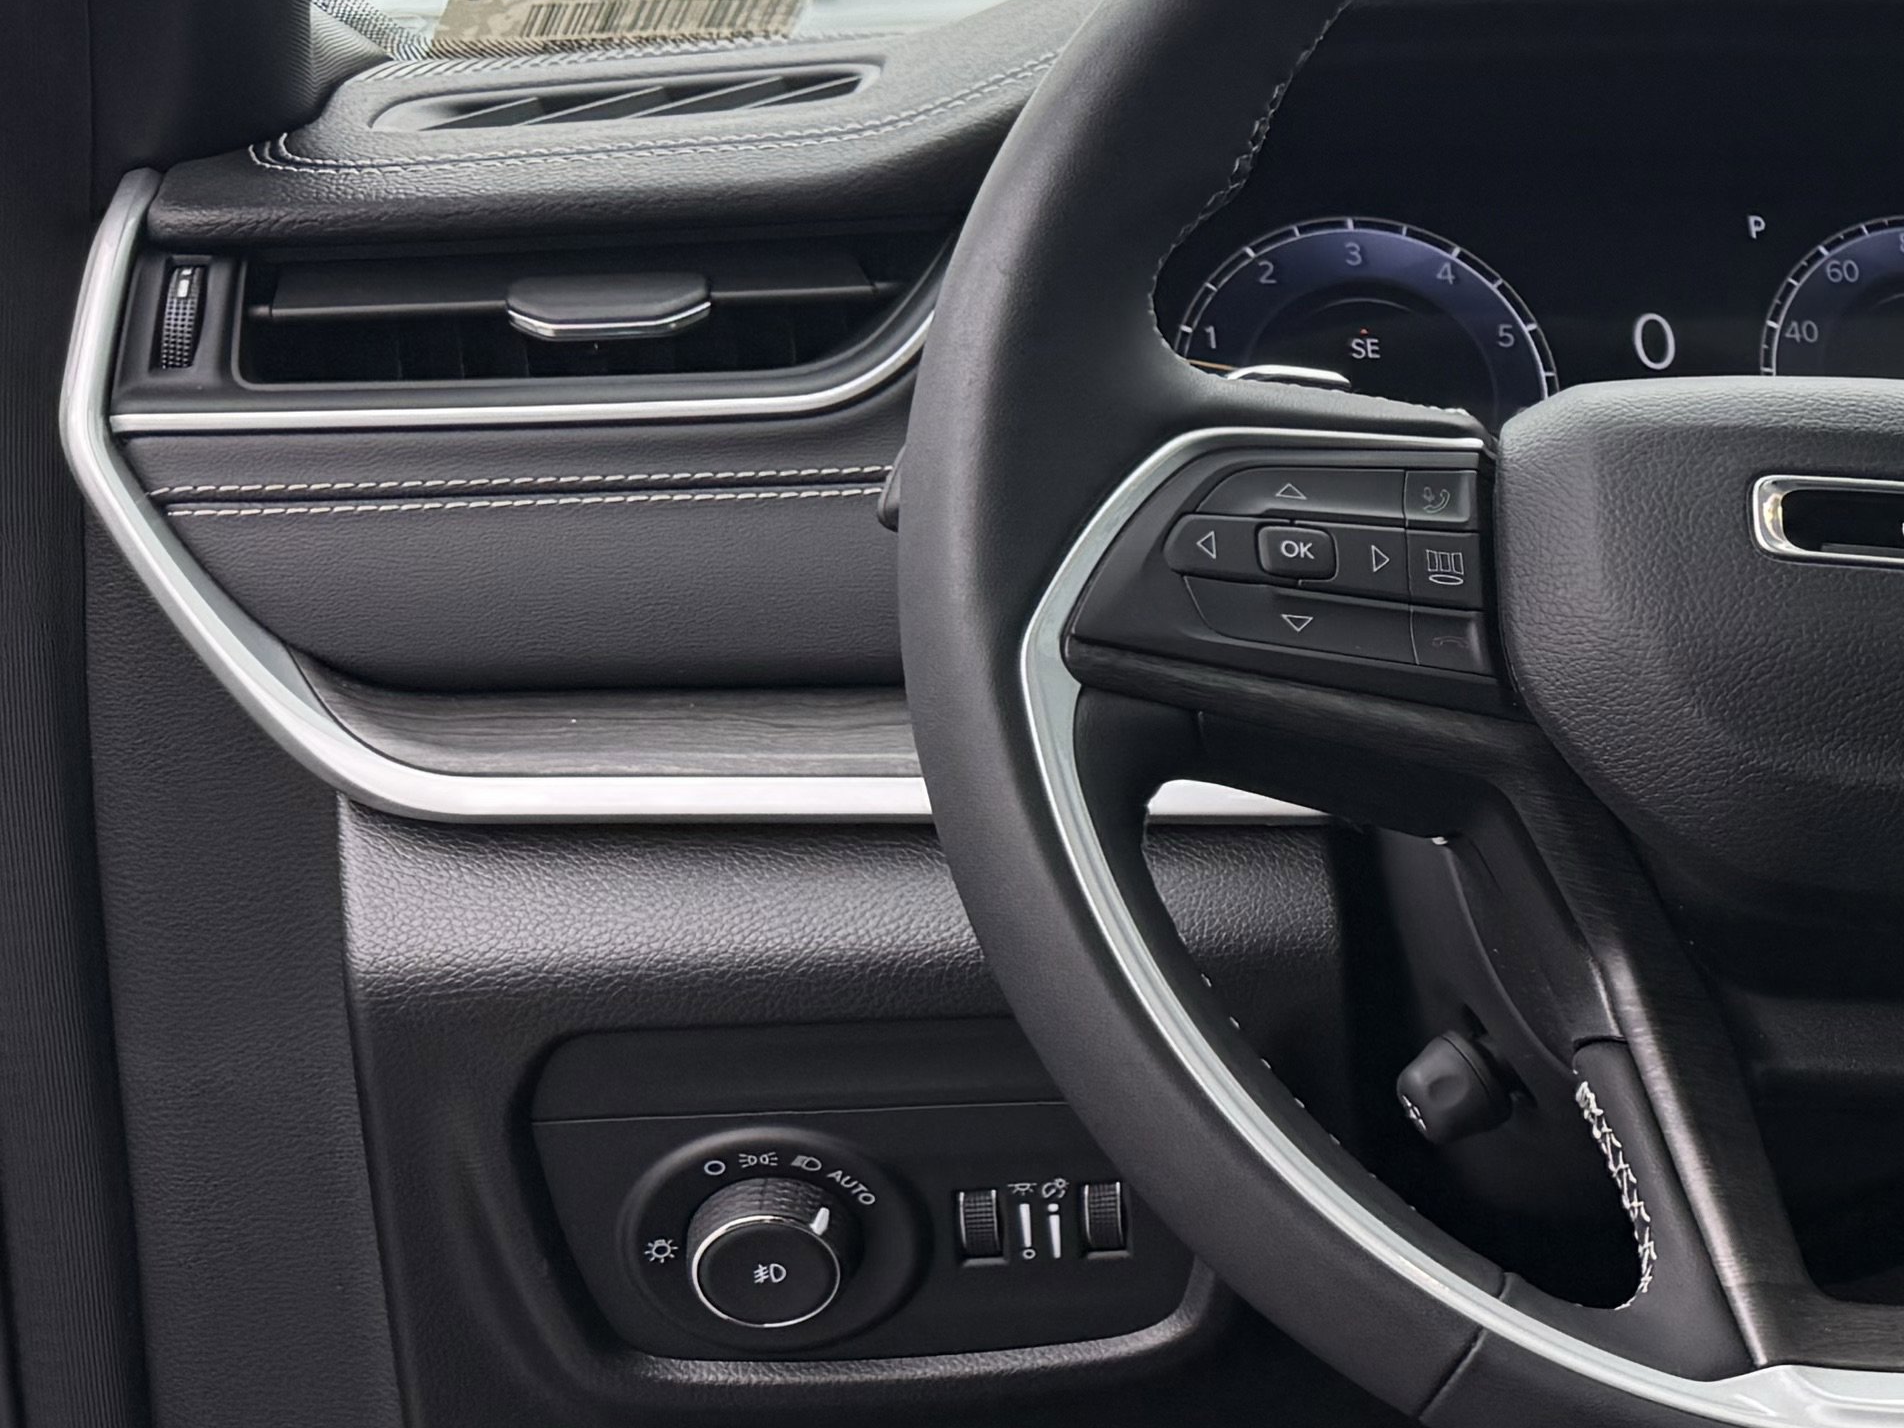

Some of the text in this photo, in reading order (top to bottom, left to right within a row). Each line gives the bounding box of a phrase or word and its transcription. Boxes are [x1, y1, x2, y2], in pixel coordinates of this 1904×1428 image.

[1748, 215, 1766, 239] P
[1345, 243, 1362, 266] 3
[1258, 262, 1277, 284] 2
[1436, 263, 1456, 285] 4
[1826, 261, 1860, 283] 60
[1204, 325, 1217, 349] 1
[1497, 324, 1515, 348] 5
[1785, 320, 1819, 343] 40
[1351, 339, 1381, 359] SE
[1280, 540, 1315, 560] OK
[827, 1169, 876, 1206] AUTO
